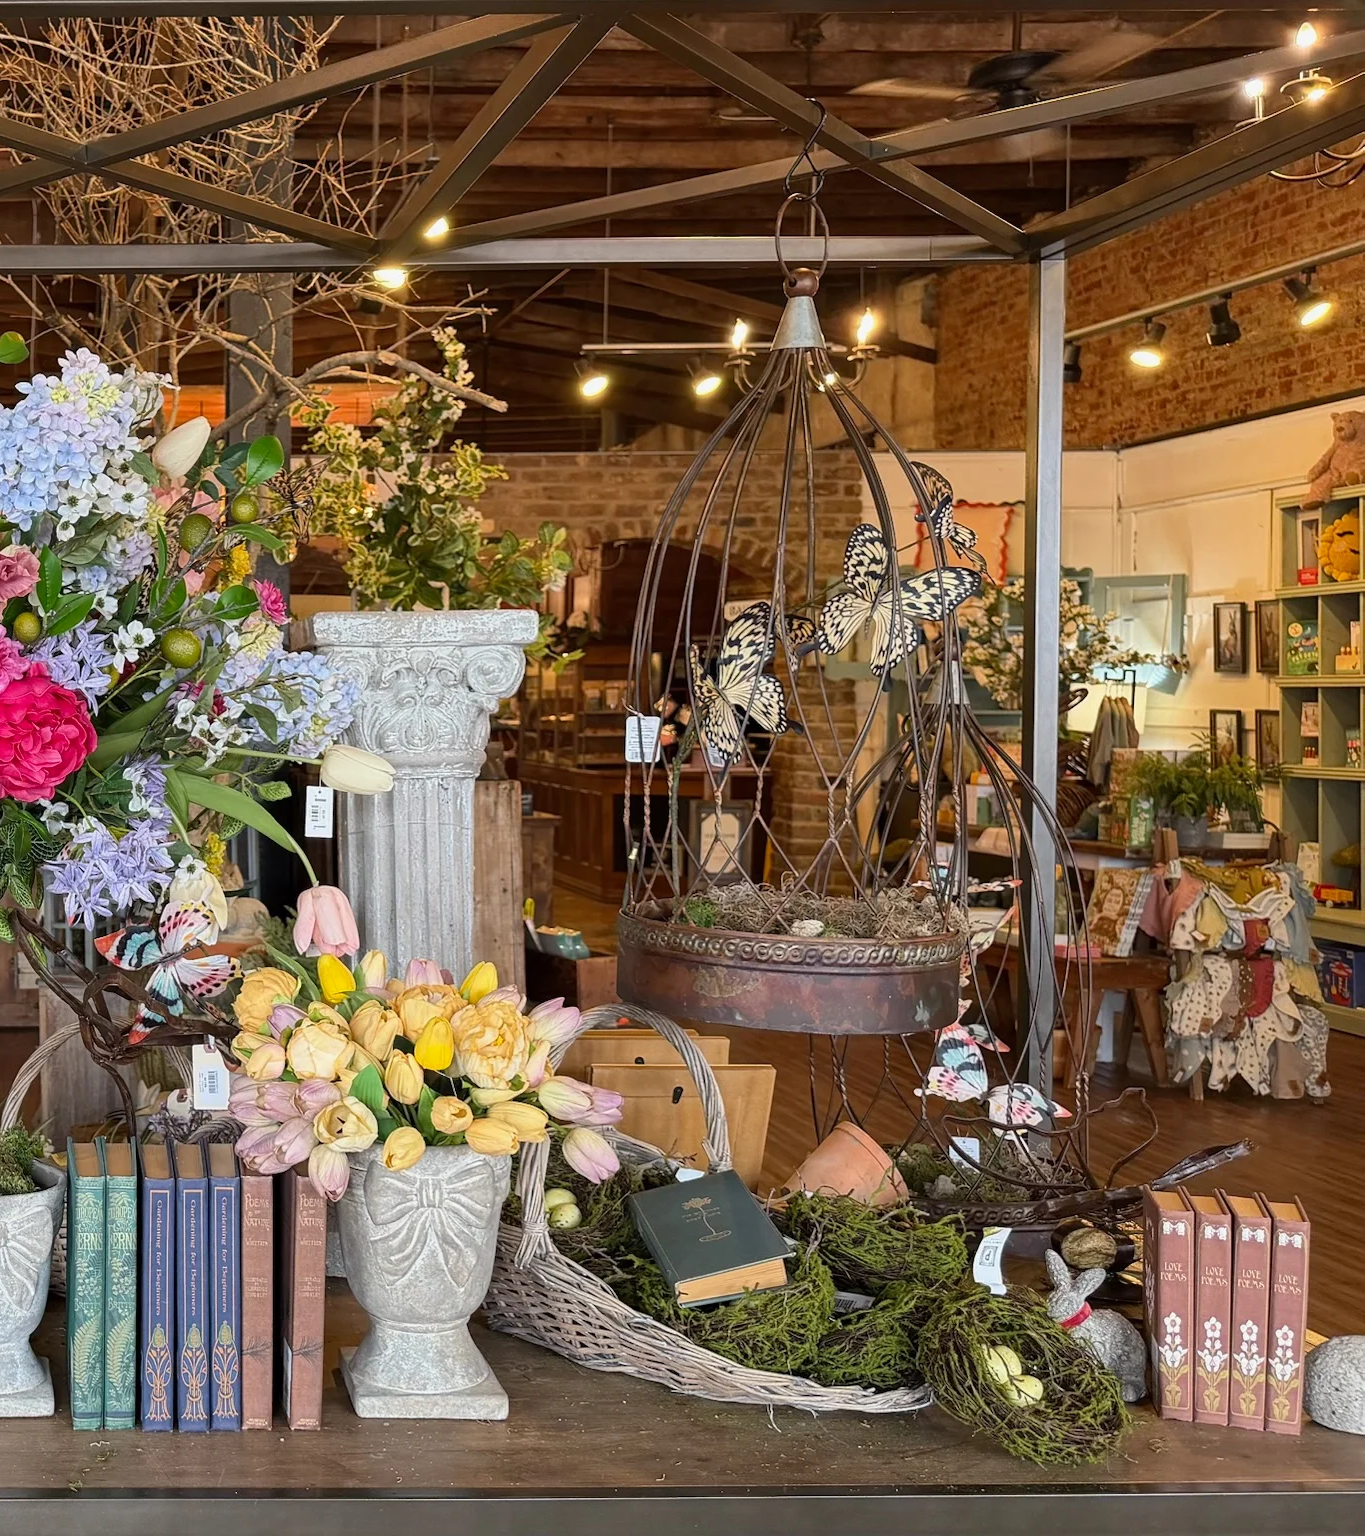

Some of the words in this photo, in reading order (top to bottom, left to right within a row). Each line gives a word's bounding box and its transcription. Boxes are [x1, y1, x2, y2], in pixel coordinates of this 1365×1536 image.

[155, 1199, 163, 1249] Gardening
[1164, 1261, 1183, 1272] LOVE
[1205, 1266, 1224, 1277] LOVE
[1160, 1271, 1187, 1282] POEMS
[1242, 1269, 1261, 1280] LOVE
[1278, 1274, 1298, 1285] LOVE
[1201, 1276, 1228, 1287] POEMS
[1237, 1279, 1265, 1289] POEMS
[1274, 1284, 1302, 1295] POEMS
